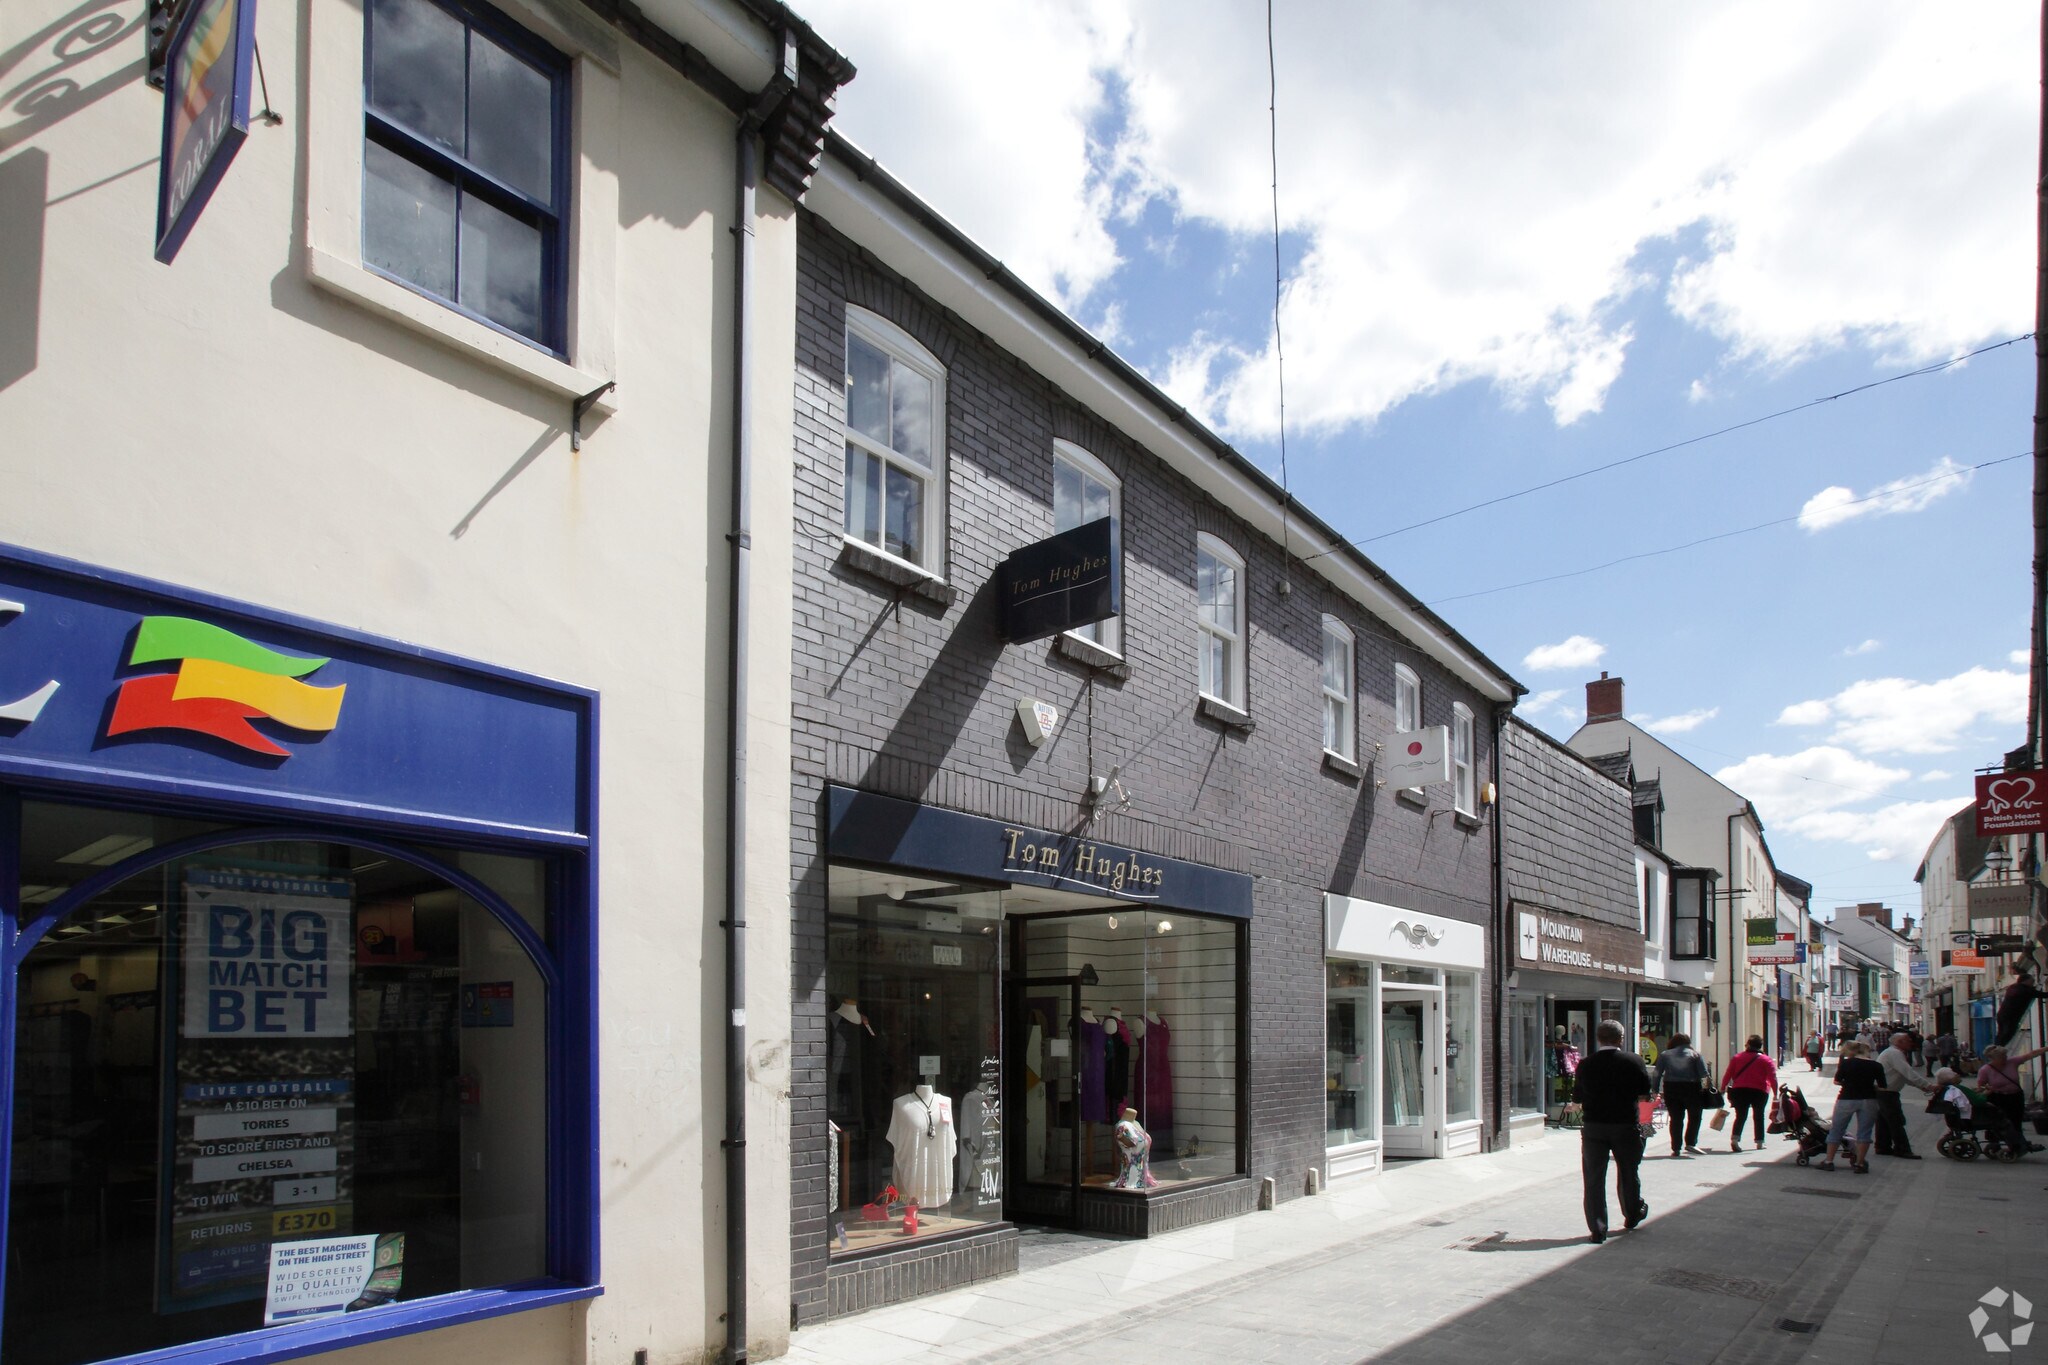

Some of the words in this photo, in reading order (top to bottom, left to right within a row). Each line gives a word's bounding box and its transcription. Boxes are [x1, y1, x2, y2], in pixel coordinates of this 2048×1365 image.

[169, 93, 228, 219] CORAL
[1012, 575, 1040, 596] Tom
[1049, 553, 1110, 583] Hughes
[1983, 814, 2013, 823] British
[2014, 812, 2041, 820] Heart
[1983, 819, 2041, 829] Foundation
[1004, 828, 1060, 868] Tom
[1076, 844, 1165, 890] Hughes
[209, 875, 244, 886] LIVE
[252, 878, 329, 893] FOOTBALL
[208, 904, 328, 962] BIG
[1541, 917, 1583, 943] MOUNTAIN
[1542, 943, 1592, 967] WAREHOUSE
[208, 961, 328, 988] MATCH
[208, 989, 328, 1033] BET
[200, 1085, 237, 1097] LIVE
[247, 1082, 332, 1095] FOOTBALL
[224, 1103, 232, 1112] A
[235, 1100, 260, 1111] £10
[262, 1099, 287, 1110] BET
[289, 1098, 307, 1108] ON
[241, 1118, 290, 1130] TORRES
[199, 1145, 216, 1156] TO
[218, 1141, 263, 1153] SCORE
[265, 1138, 302, 1150] FIRST
[304, 1136, 331, 1148] AND
[238, 1159, 294, 1172] CHELSEA
[292, 1186, 300, 1196] 3
[980, 1167, 999, 1199] ZEN
[192, 1197, 209, 1208] TO
[212, 1193, 239, 1205] WIN
[191, 1221, 253, 1240] RETURNS
[278, 1212, 331, 1232] £370
[212, 1244, 257, 1257] RAISING
[298, 1247, 320, 1256] BEST
[322, 1242, 367, 1253] MACHINES
[278, 1258, 291, 1266] ON
[293, 1255, 310, 1264] THE
[312, 1253, 334, 1263] HIGH
[276, 1265, 363, 1281] WIDESCREENS
[275, 1284, 294, 1293] HD
[302, 1276, 362, 1291] QUALITY
[274, 1294, 302, 1303] SWIPE
[307, 1287, 361, 1299] TECHNOLOGY
